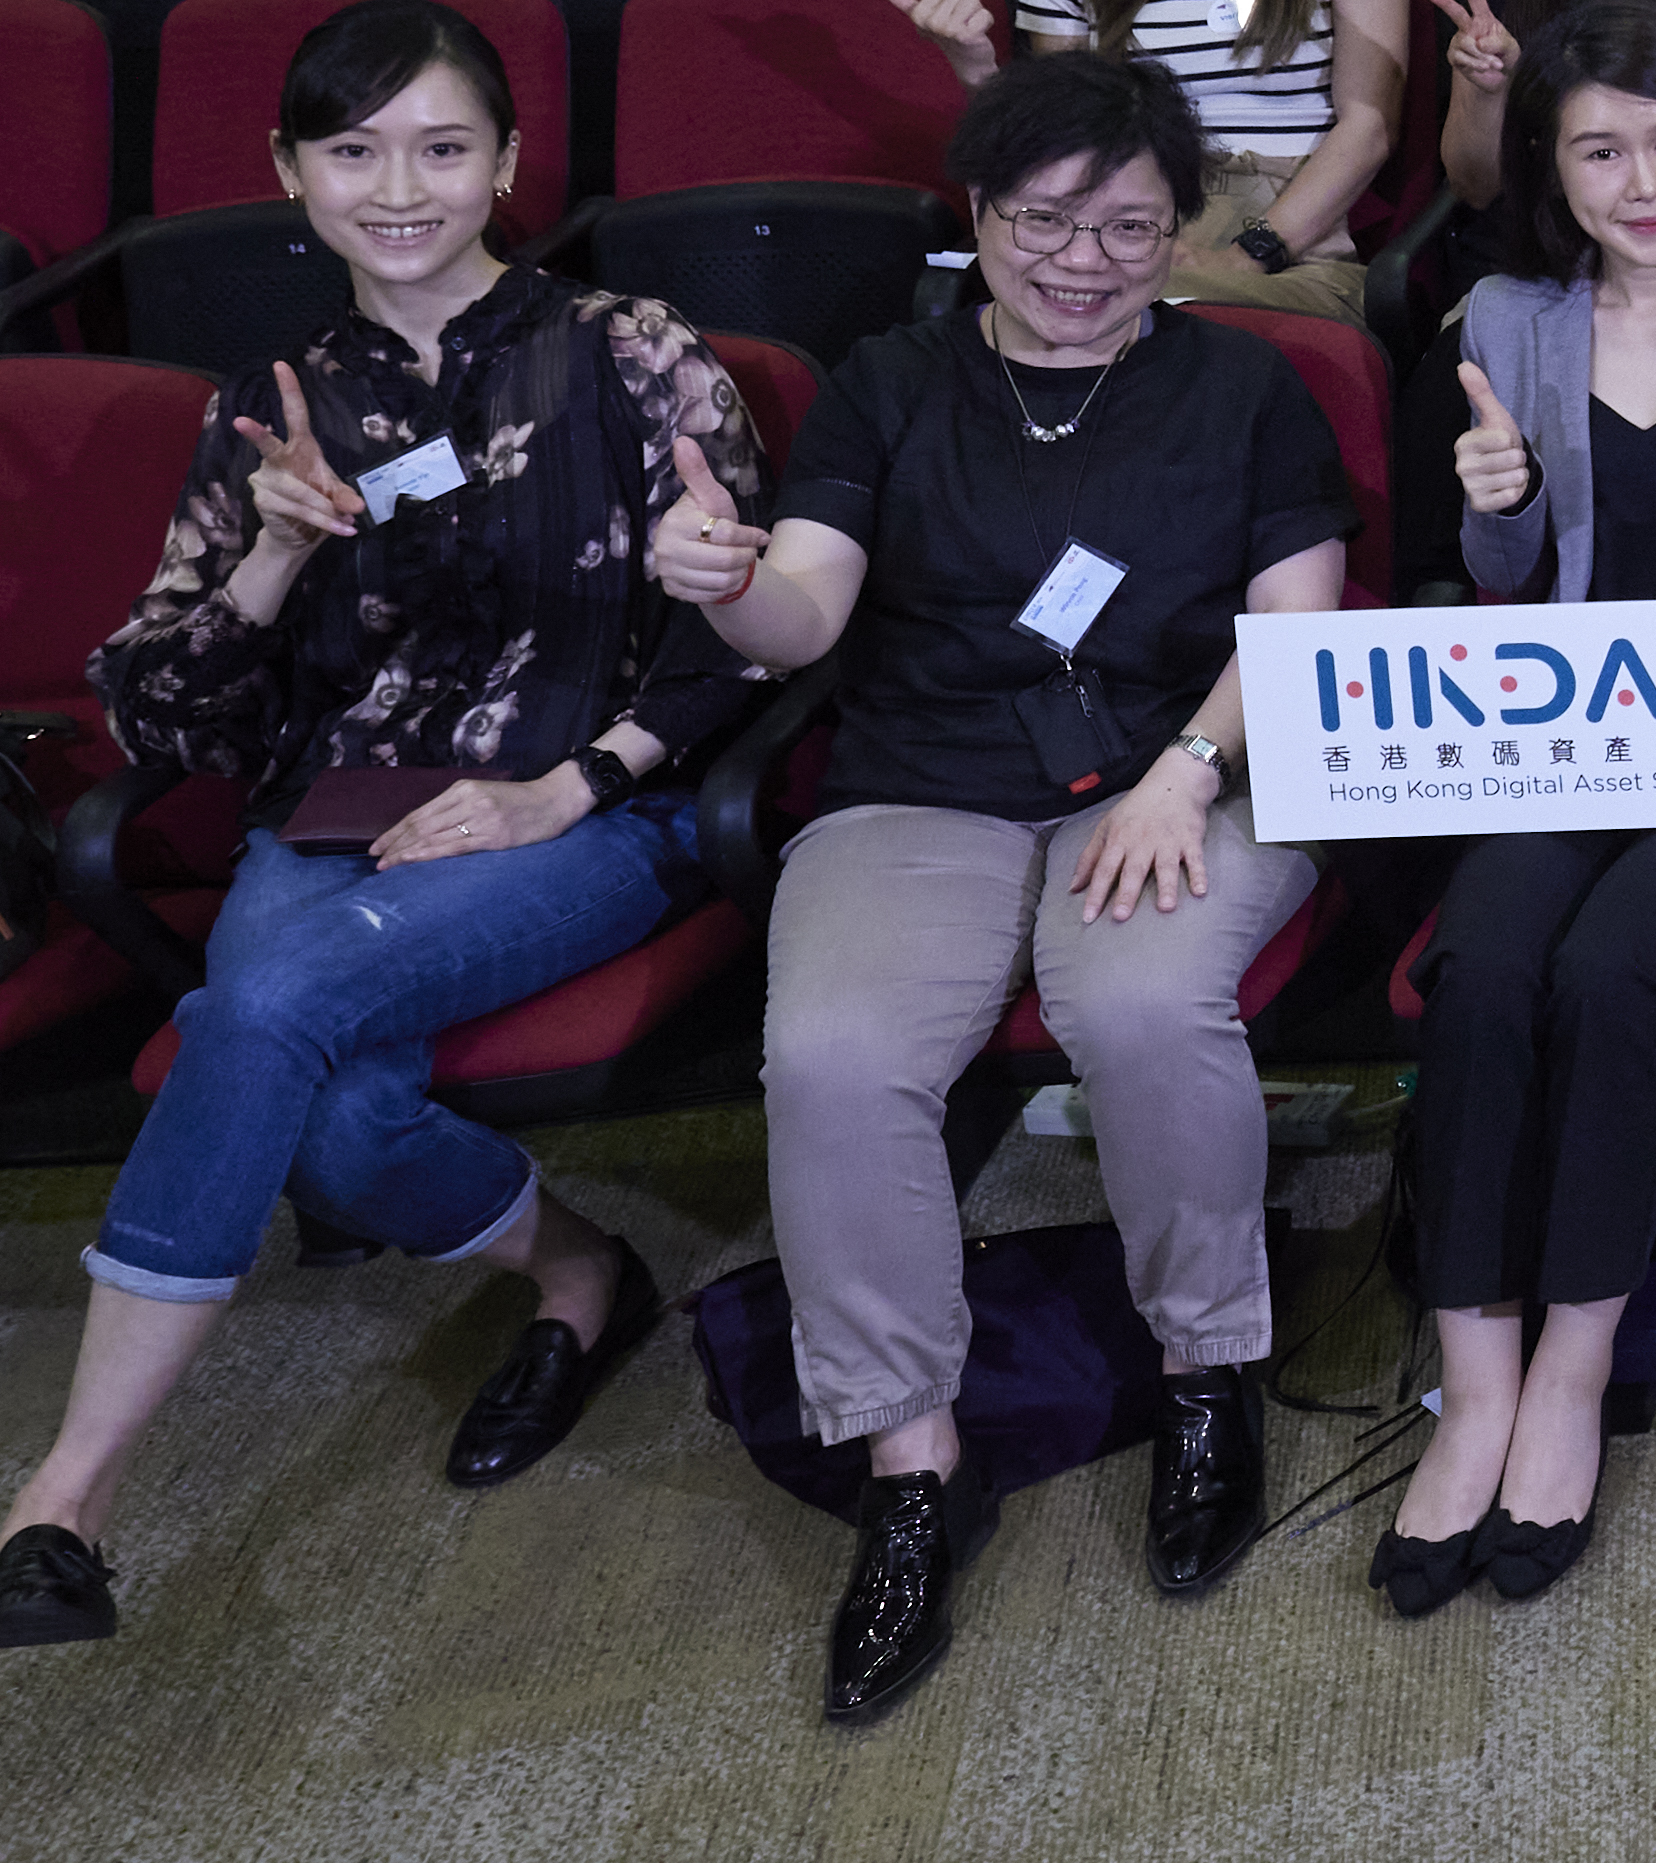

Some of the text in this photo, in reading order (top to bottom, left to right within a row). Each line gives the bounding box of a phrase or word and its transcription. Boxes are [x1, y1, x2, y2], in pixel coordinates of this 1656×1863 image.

[1328, 777, 1399, 804] Hong
[1406, 774, 1473, 802] Kong
[1482, 772, 1565, 799] Digital
[1572, 771, 1644, 795] Asset
